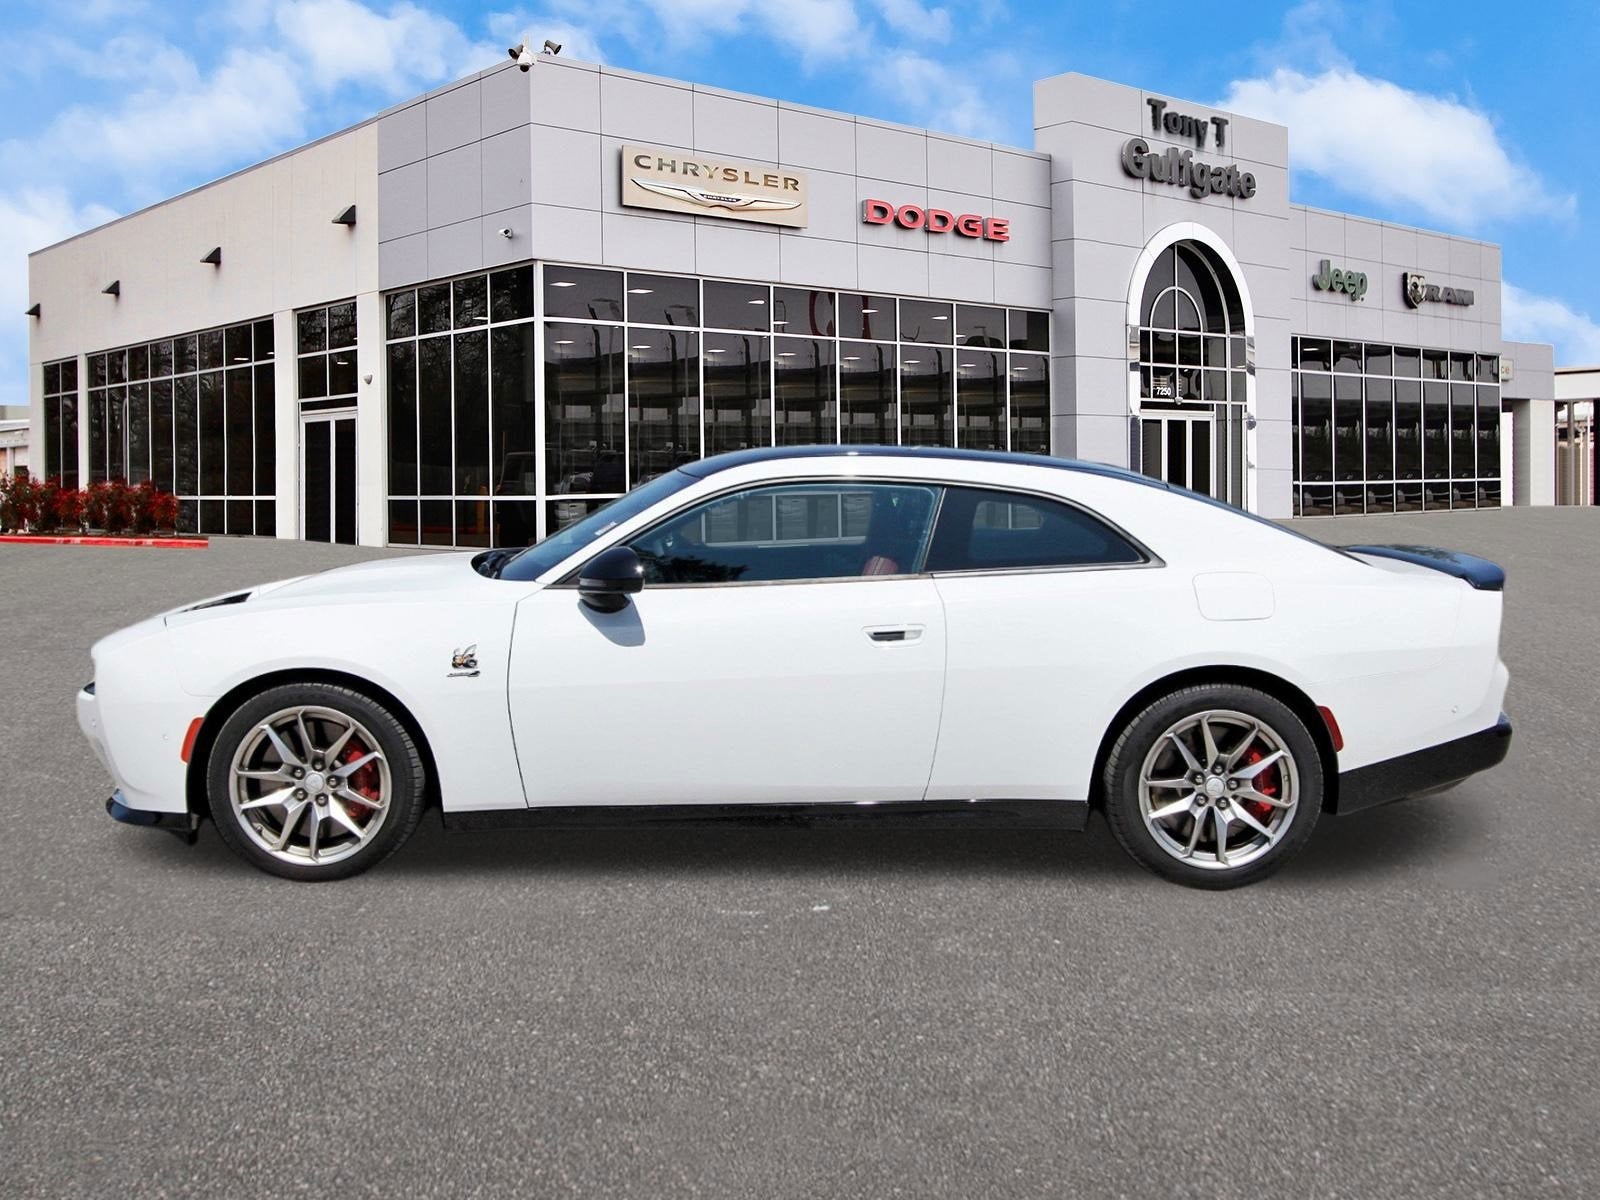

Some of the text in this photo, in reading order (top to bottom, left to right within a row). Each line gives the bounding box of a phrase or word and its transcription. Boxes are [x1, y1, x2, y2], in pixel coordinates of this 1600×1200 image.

[1146, 98, 1229, 147] Tony T
[633, 154, 800, 192] CHRYSLER
[1121, 138, 1257, 199] Gulfgate
[862, 198, 1011, 243] DODGE
[1312, 259, 1369, 301] Jeep
[1425, 284, 1475, 307] RAM
[1156, 387, 1172, 396] 7250
